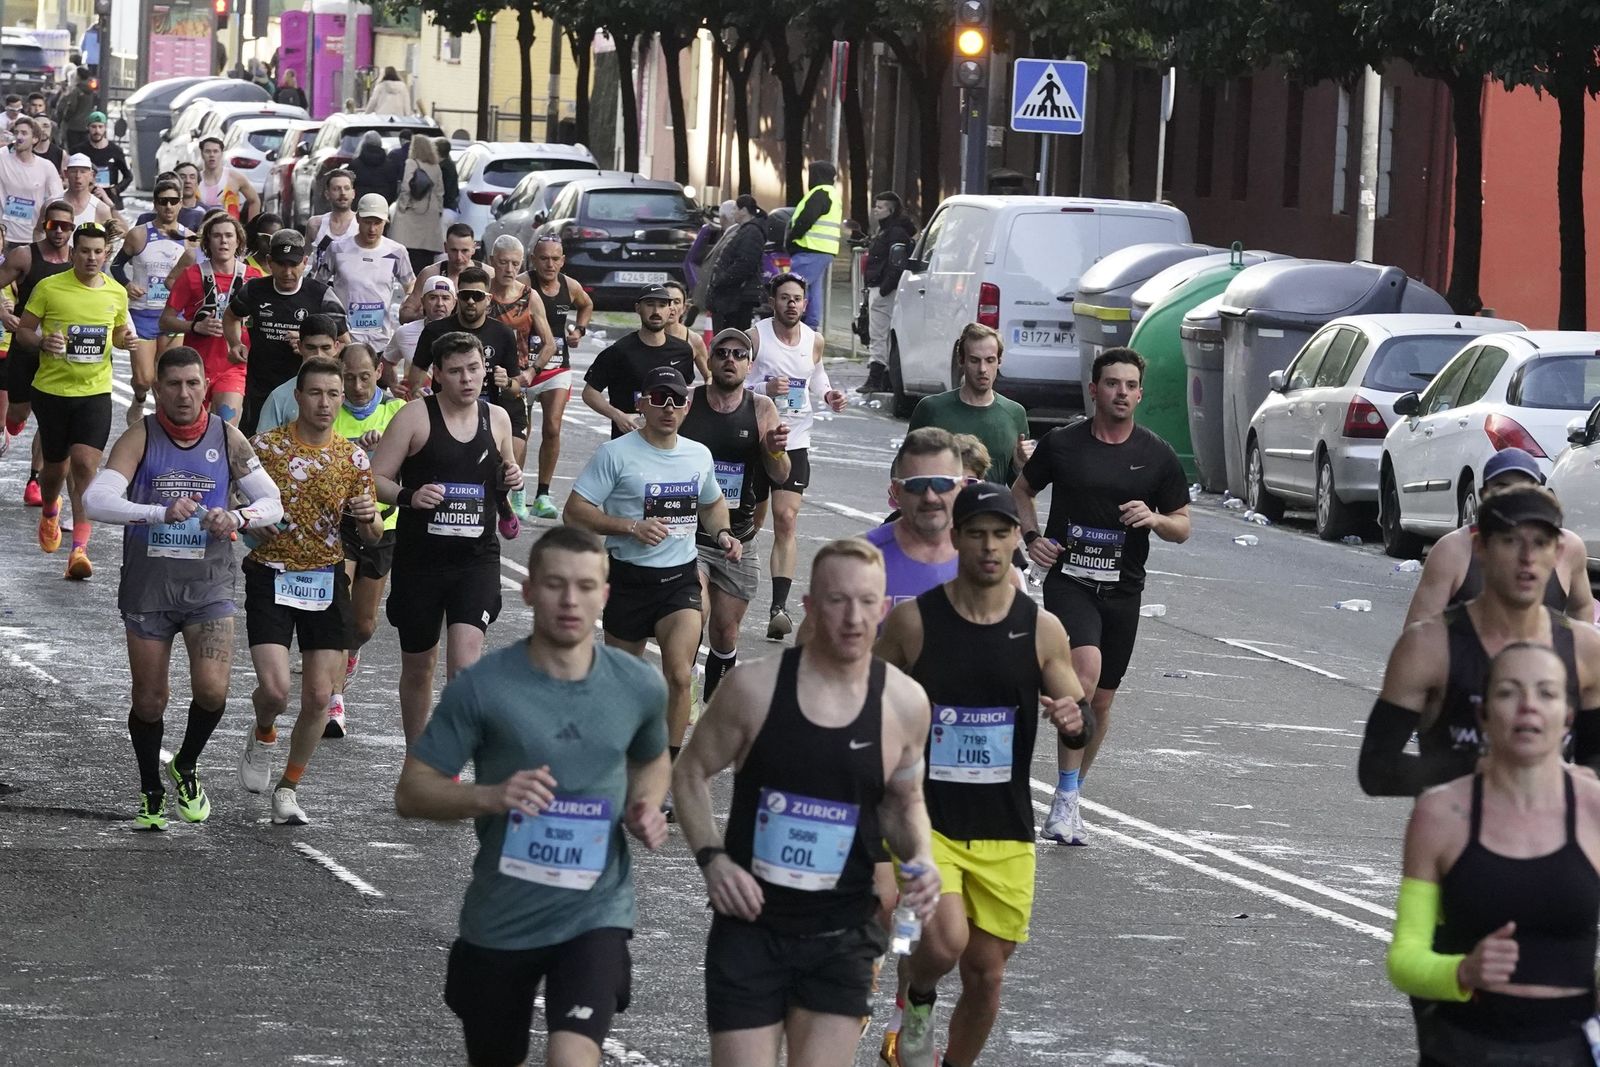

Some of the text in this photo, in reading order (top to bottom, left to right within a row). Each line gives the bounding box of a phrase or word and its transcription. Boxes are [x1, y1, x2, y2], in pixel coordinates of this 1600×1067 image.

[1021, 331, 1076, 344] 9177 MFY
[74, 345, 101, 354] VICTOR
[449, 486, 479, 495] ZURICH
[664, 484, 694, 493] ZURICH
[449, 502, 467, 511] 4124
[664, 501, 681, 509] 4246
[433, 511, 480, 525] ANDREW
[168, 523, 186, 531] 7930
[1086, 530, 1118, 540] ZURICH
[1084, 545, 1103, 555] 5047
[1069, 552, 1116, 569] ENRIQUE
[296, 575, 313, 584] 9403
[281, 584, 326, 599] PAQUITO
[962, 712, 1007, 723] ZURICH
[962, 734, 988, 745] 7199
[957, 749, 991, 765] LUIS
[548, 800, 603, 816] ZURICH
[791, 801, 848, 821] ZURICH
[528, 841, 583, 865] COLIN
[781, 845, 816, 868] COL
